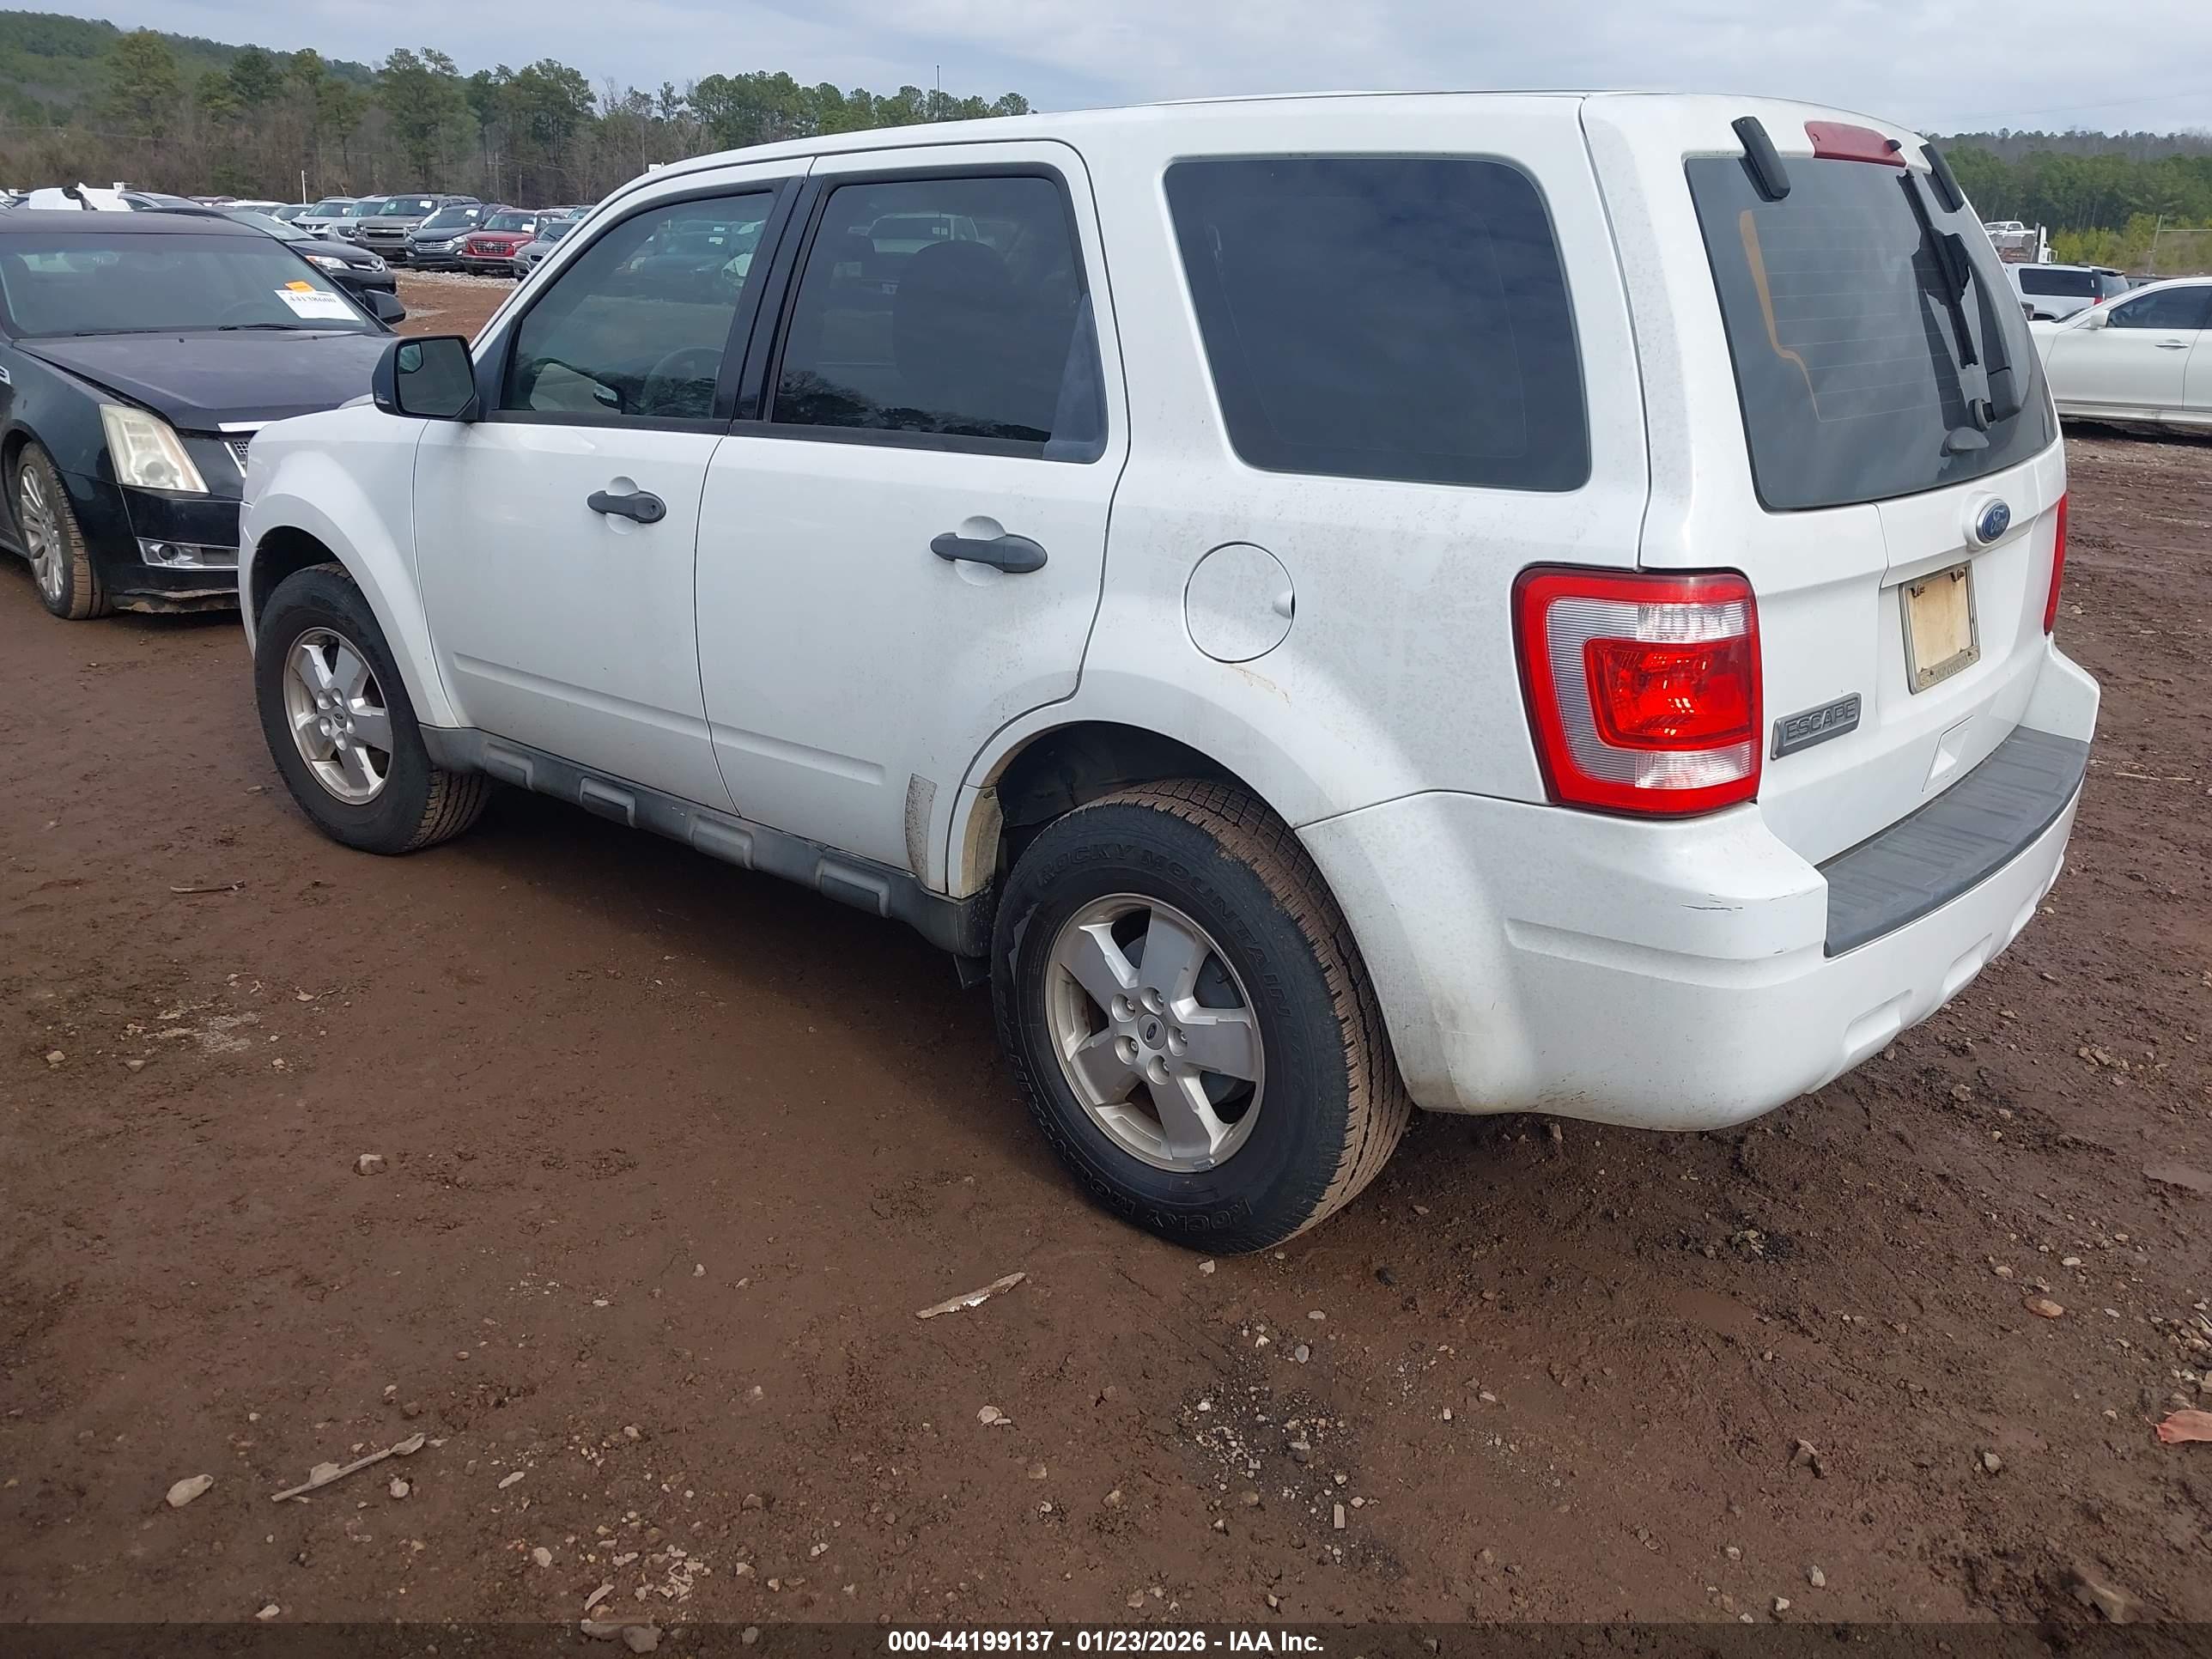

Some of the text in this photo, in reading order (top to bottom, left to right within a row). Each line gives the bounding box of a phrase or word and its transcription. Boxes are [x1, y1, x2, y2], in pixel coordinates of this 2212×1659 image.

[1784, 699, 1856, 739] ESCAPE
[1036, 842, 1138, 888] ROCKY
[1139, 848, 1293, 1018] MOUNTAIN
